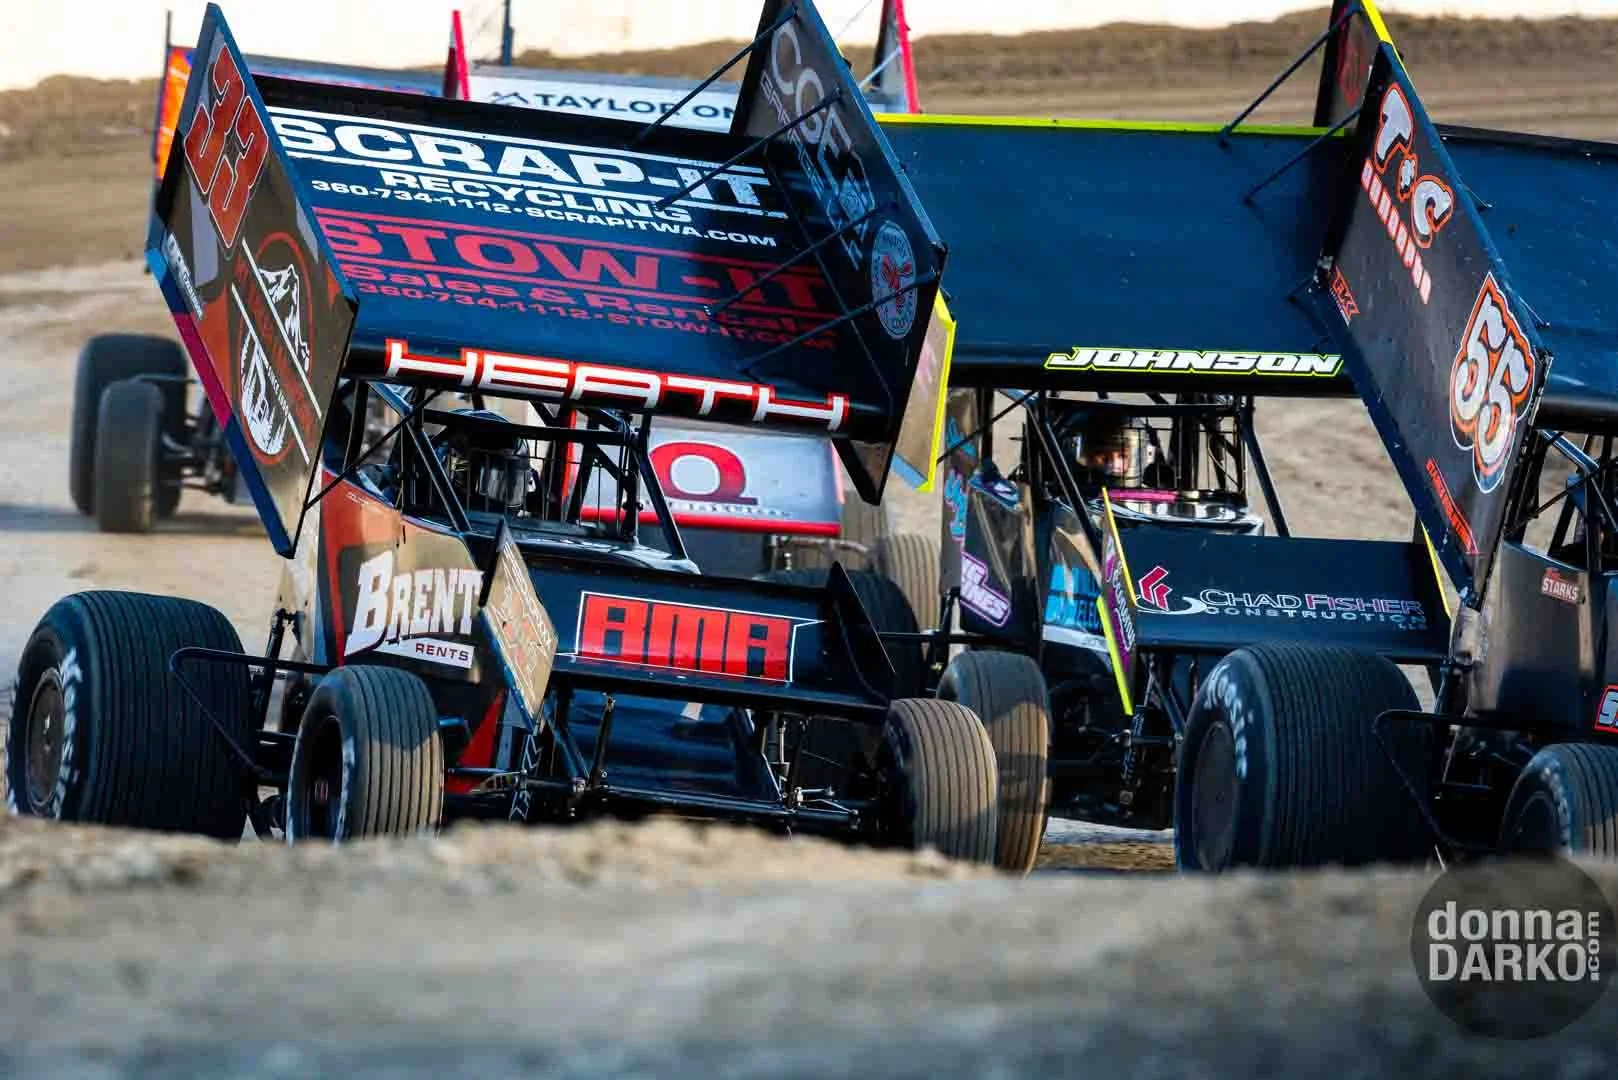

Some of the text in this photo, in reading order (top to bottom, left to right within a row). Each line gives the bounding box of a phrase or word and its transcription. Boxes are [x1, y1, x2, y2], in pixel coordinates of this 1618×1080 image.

[534, 93, 680, 116] TAYLOR
[270, 116, 771, 207] SCRAP-IT
[381, 170, 692, 222] RECYCLING
[1046, 348, 1342, 375] JOHNSON
[385, 338, 849, 432] HEATH
[1543, 577, 1579, 601] STARKS
[1205, 607, 1427, 624] CONSTRUCTION
[415, 642, 470, 661] RENTS
[581, 595, 791, 682] AMA
